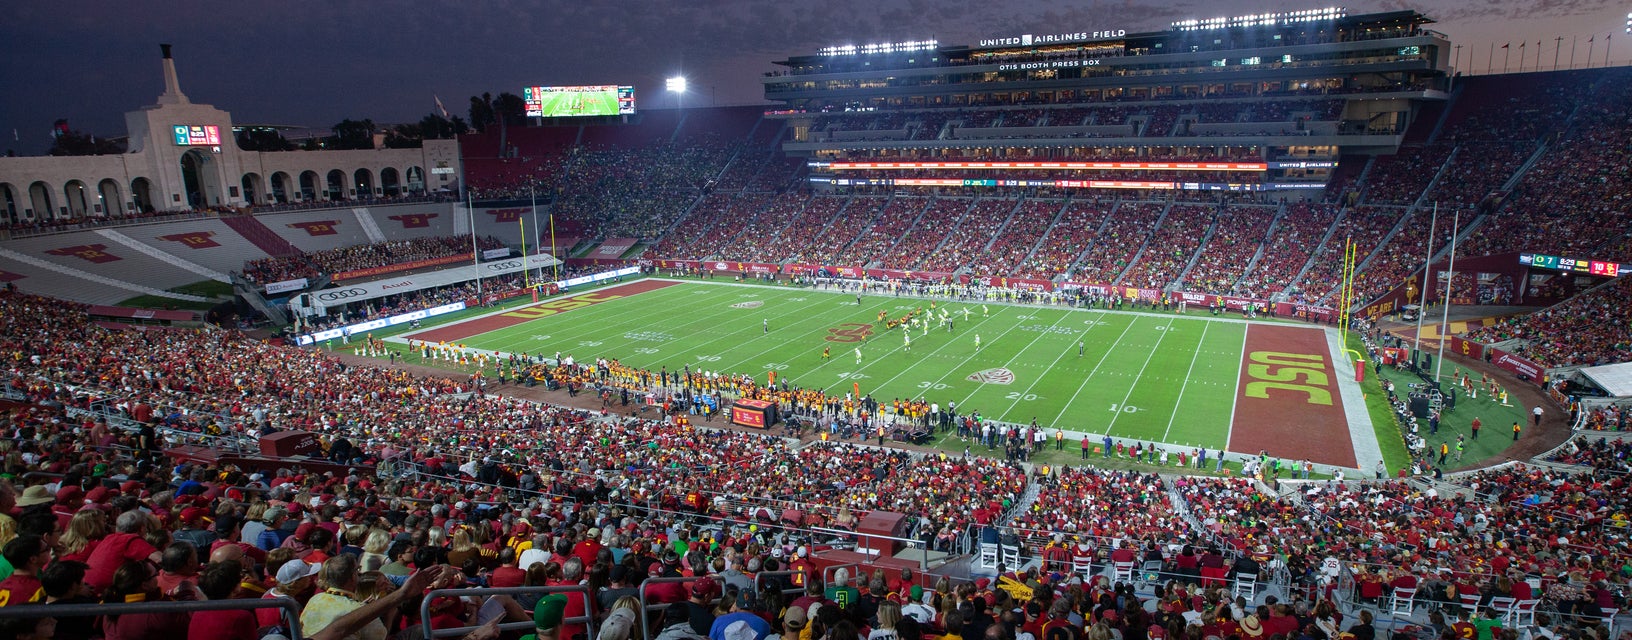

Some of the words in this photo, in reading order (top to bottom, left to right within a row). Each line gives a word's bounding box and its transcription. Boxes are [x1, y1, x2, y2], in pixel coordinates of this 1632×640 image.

[980, 37, 1020, 46] UNITED
[1034, 32, 1087, 43] AIRLINES
[1093, 29, 1126, 39] FIELD
[1052, 60, 1079, 68] PRESS
[309, 224, 329, 232] 33
[184, 236, 207, 244] 12
[1559, 258, 1576, 266] 8:29
[1594, 263, 1604, 271] 10
[382, 280, 413, 291] Audi
[1182, 292, 1206, 301] WARE
[501, 293, 623, 319] USC
[1367, 305, 1379, 316] WE
[1380, 302, 1392, 313] ARE
[762, 363, 789, 371] 50
[1245, 351, 1333, 405] USC
[917, 381, 948, 390] 30
[1005, 392, 1038, 401] 20
[1108, 403, 1138, 413] 10
[1328, 560, 1336, 568] 25
